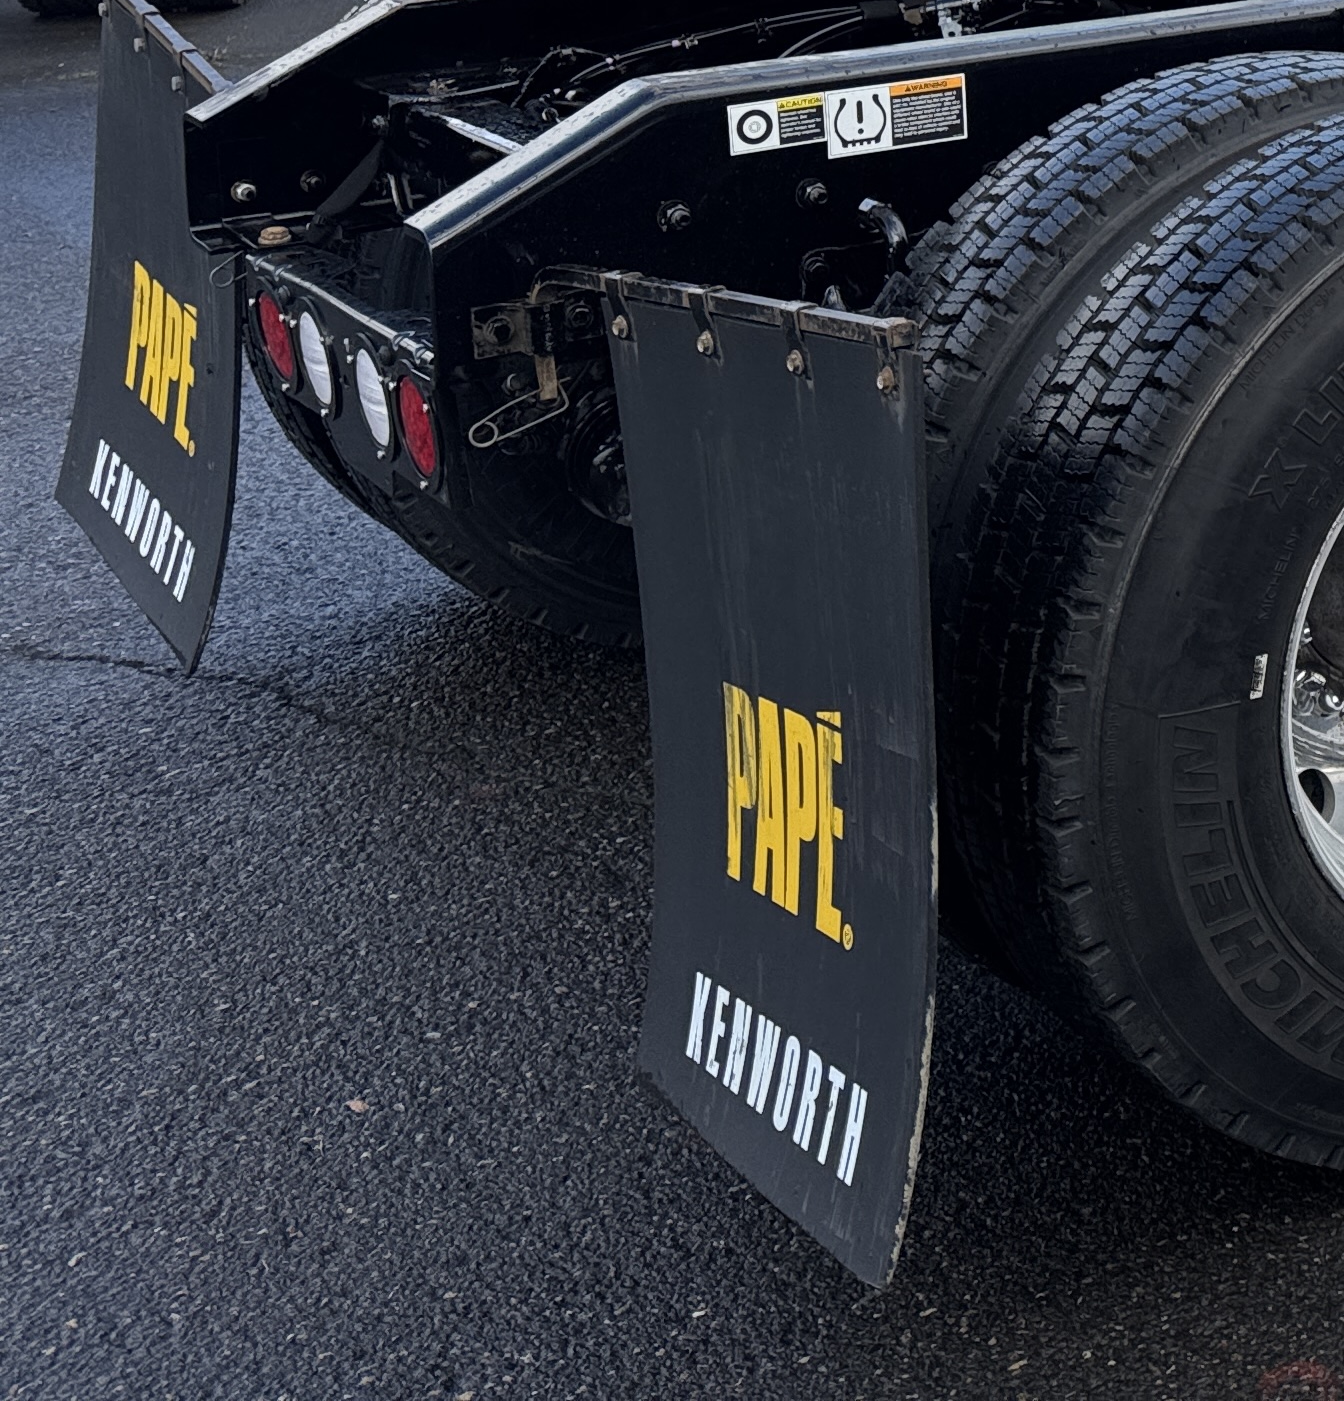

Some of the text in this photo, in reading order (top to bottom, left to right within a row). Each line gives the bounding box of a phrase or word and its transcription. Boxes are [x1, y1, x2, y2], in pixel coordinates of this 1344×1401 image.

[785, 96, 822, 108] CAUTION
[910, 80, 948, 92] WARNING
[89, 438, 196, 603] KENWORTH
[1255, 530, 1301, 621] MICHELIN
[722, 680, 844, 944] PAPÉ
[686, 971, 869, 1188] KENWORTH
